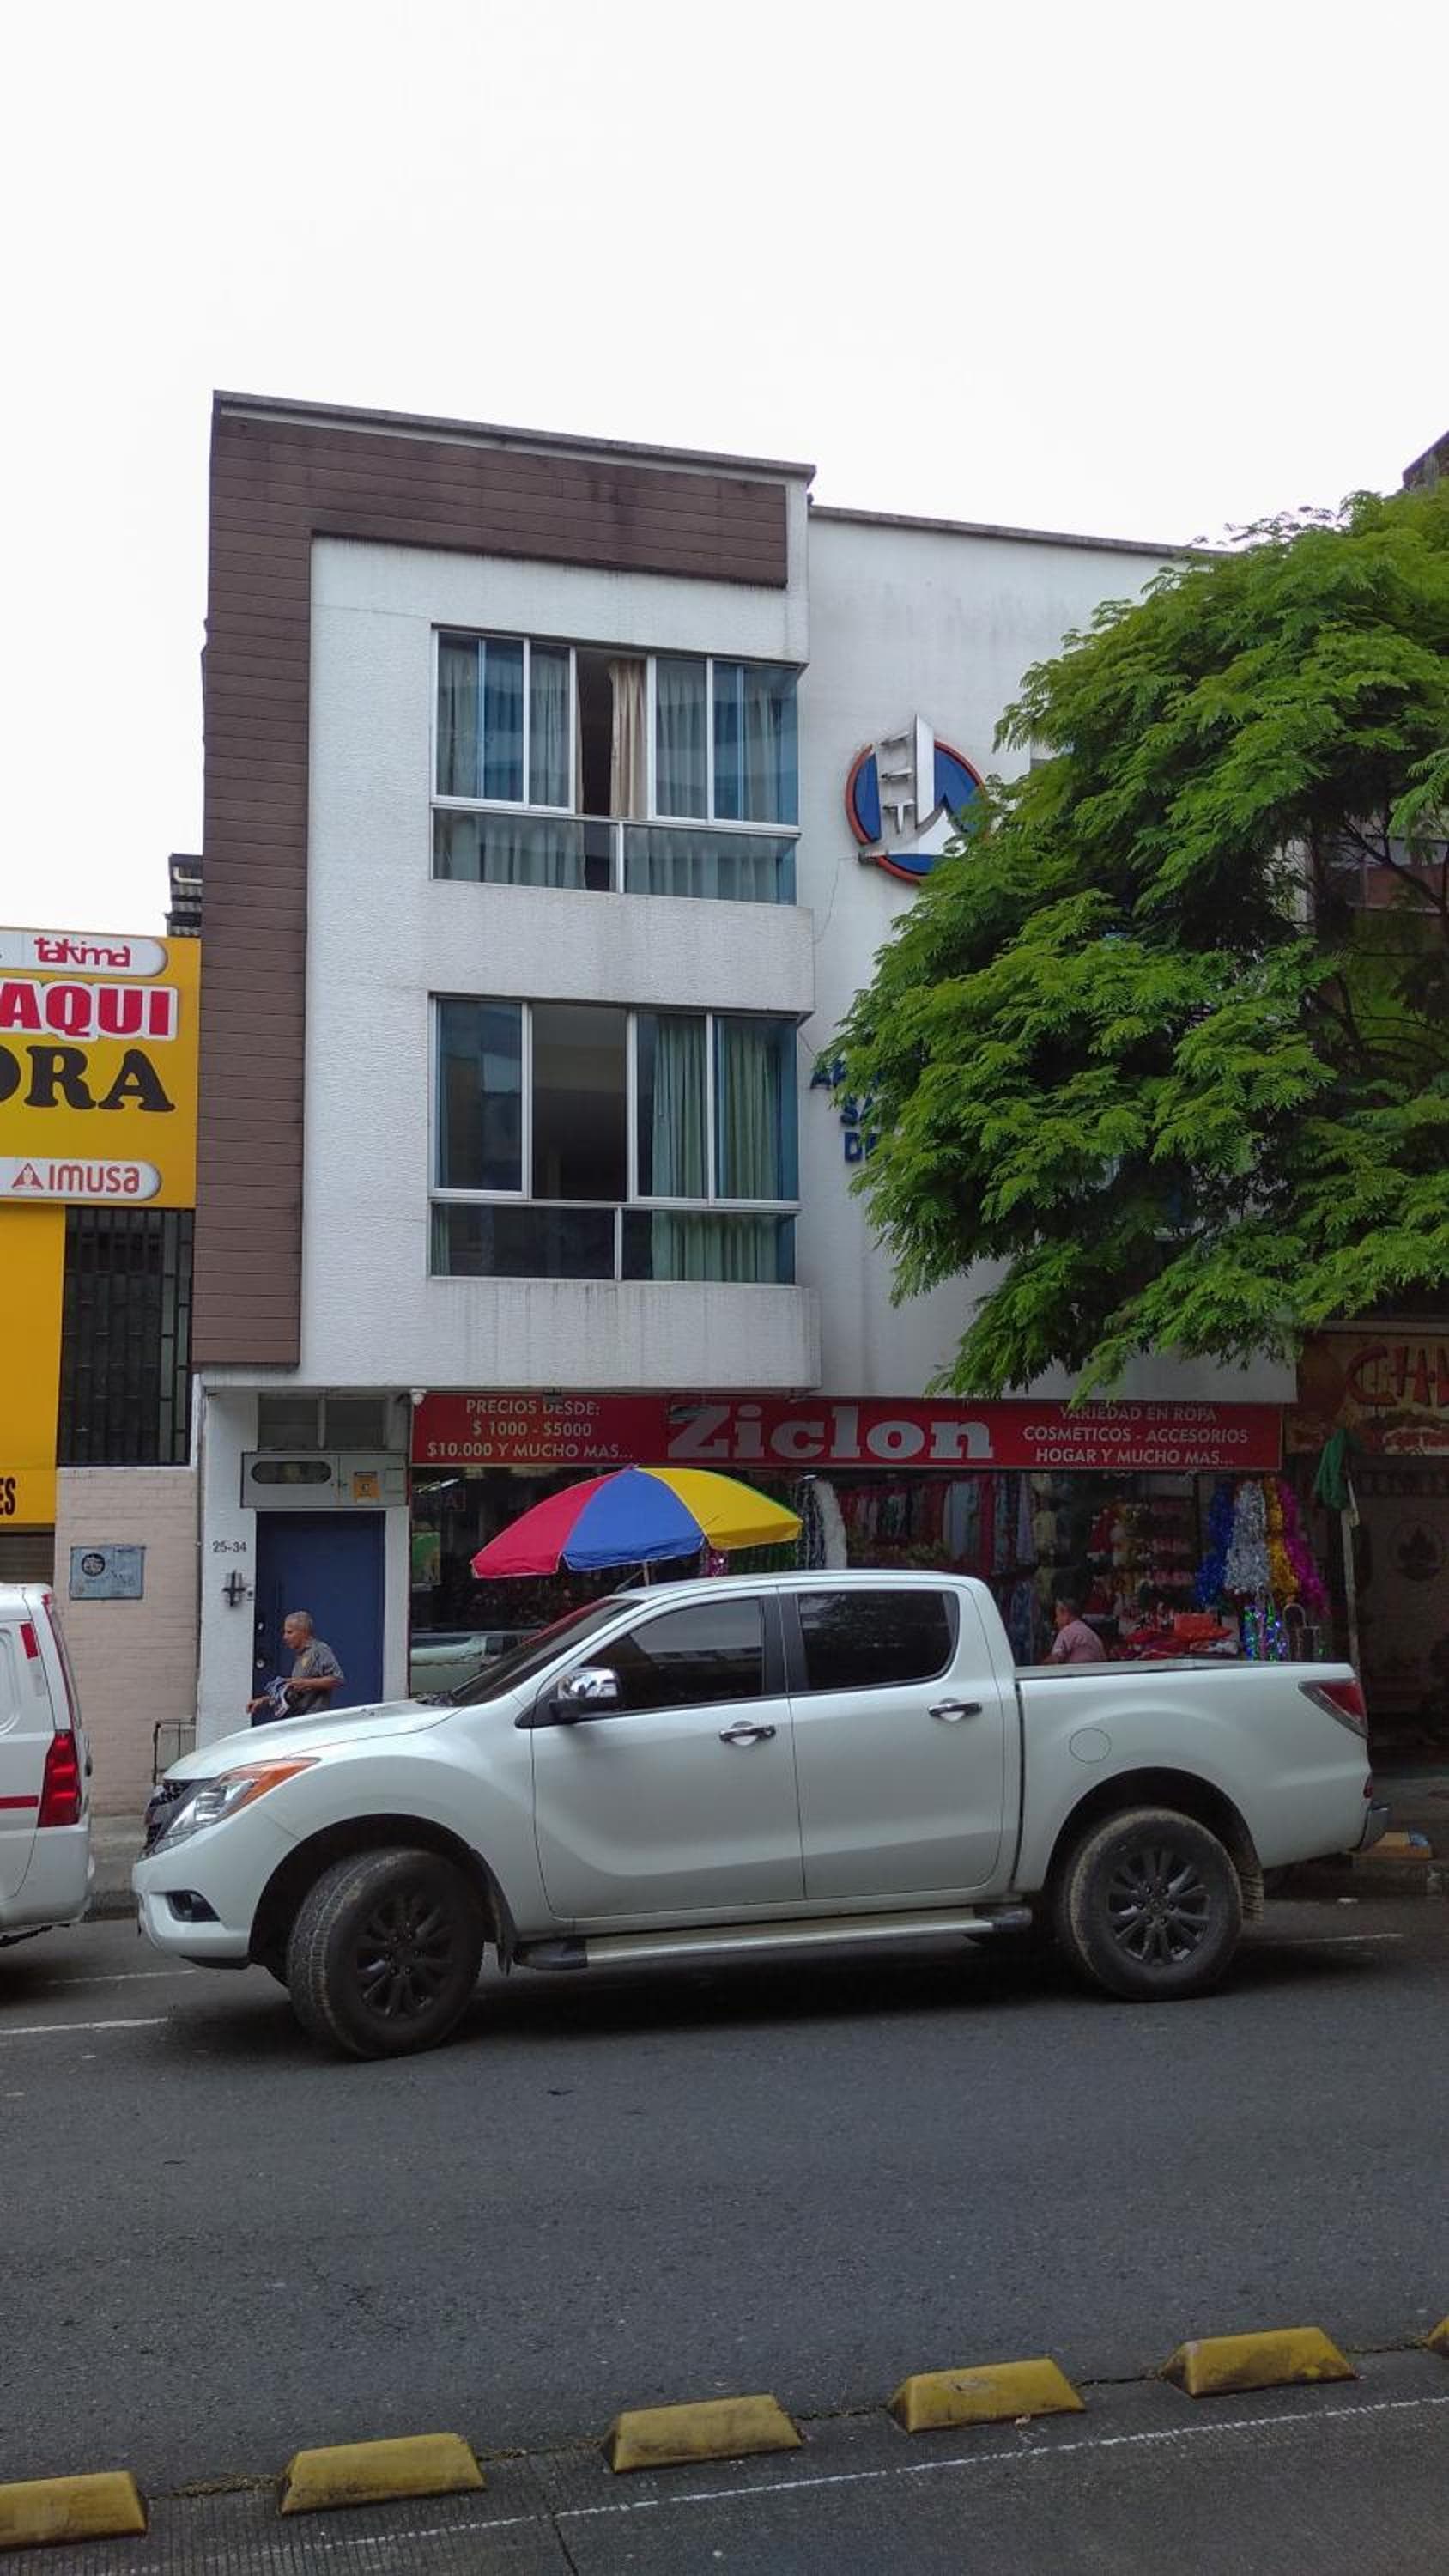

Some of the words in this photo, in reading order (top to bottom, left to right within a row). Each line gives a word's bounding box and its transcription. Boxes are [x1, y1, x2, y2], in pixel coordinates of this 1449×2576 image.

[466, 1400, 537, 1415] PRECIOS
[543, 1400, 600, 1416] DESDE:
[1059, 1406, 1142, 1421] VARIEDAD
[1145, 1408, 1169, 1421] EN
[1174, 1408, 1217, 1422] ROPA
[488, 1422, 528, 1437] 1000
[543, 1422, 591, 1437] $5000
[667, 1404, 993, 1460] Ziclon
[1022, 1425, 1131, 1443] COSMETICOS
[1145, 1428, 1248, 1443] ACCESORIOS
[427, 1442, 493, 1458] $10.000
[497, 1443, 509, 1457] Y
[513, 1443, 579, 1458] MUCHO
[1035, 1447, 1096, 1463] HOGAR
[1100, 1449, 1113, 1463] Y
[1117, 1449, 1180, 1464] MUCHO
[212, 1540, 247, 1553] 25-34
